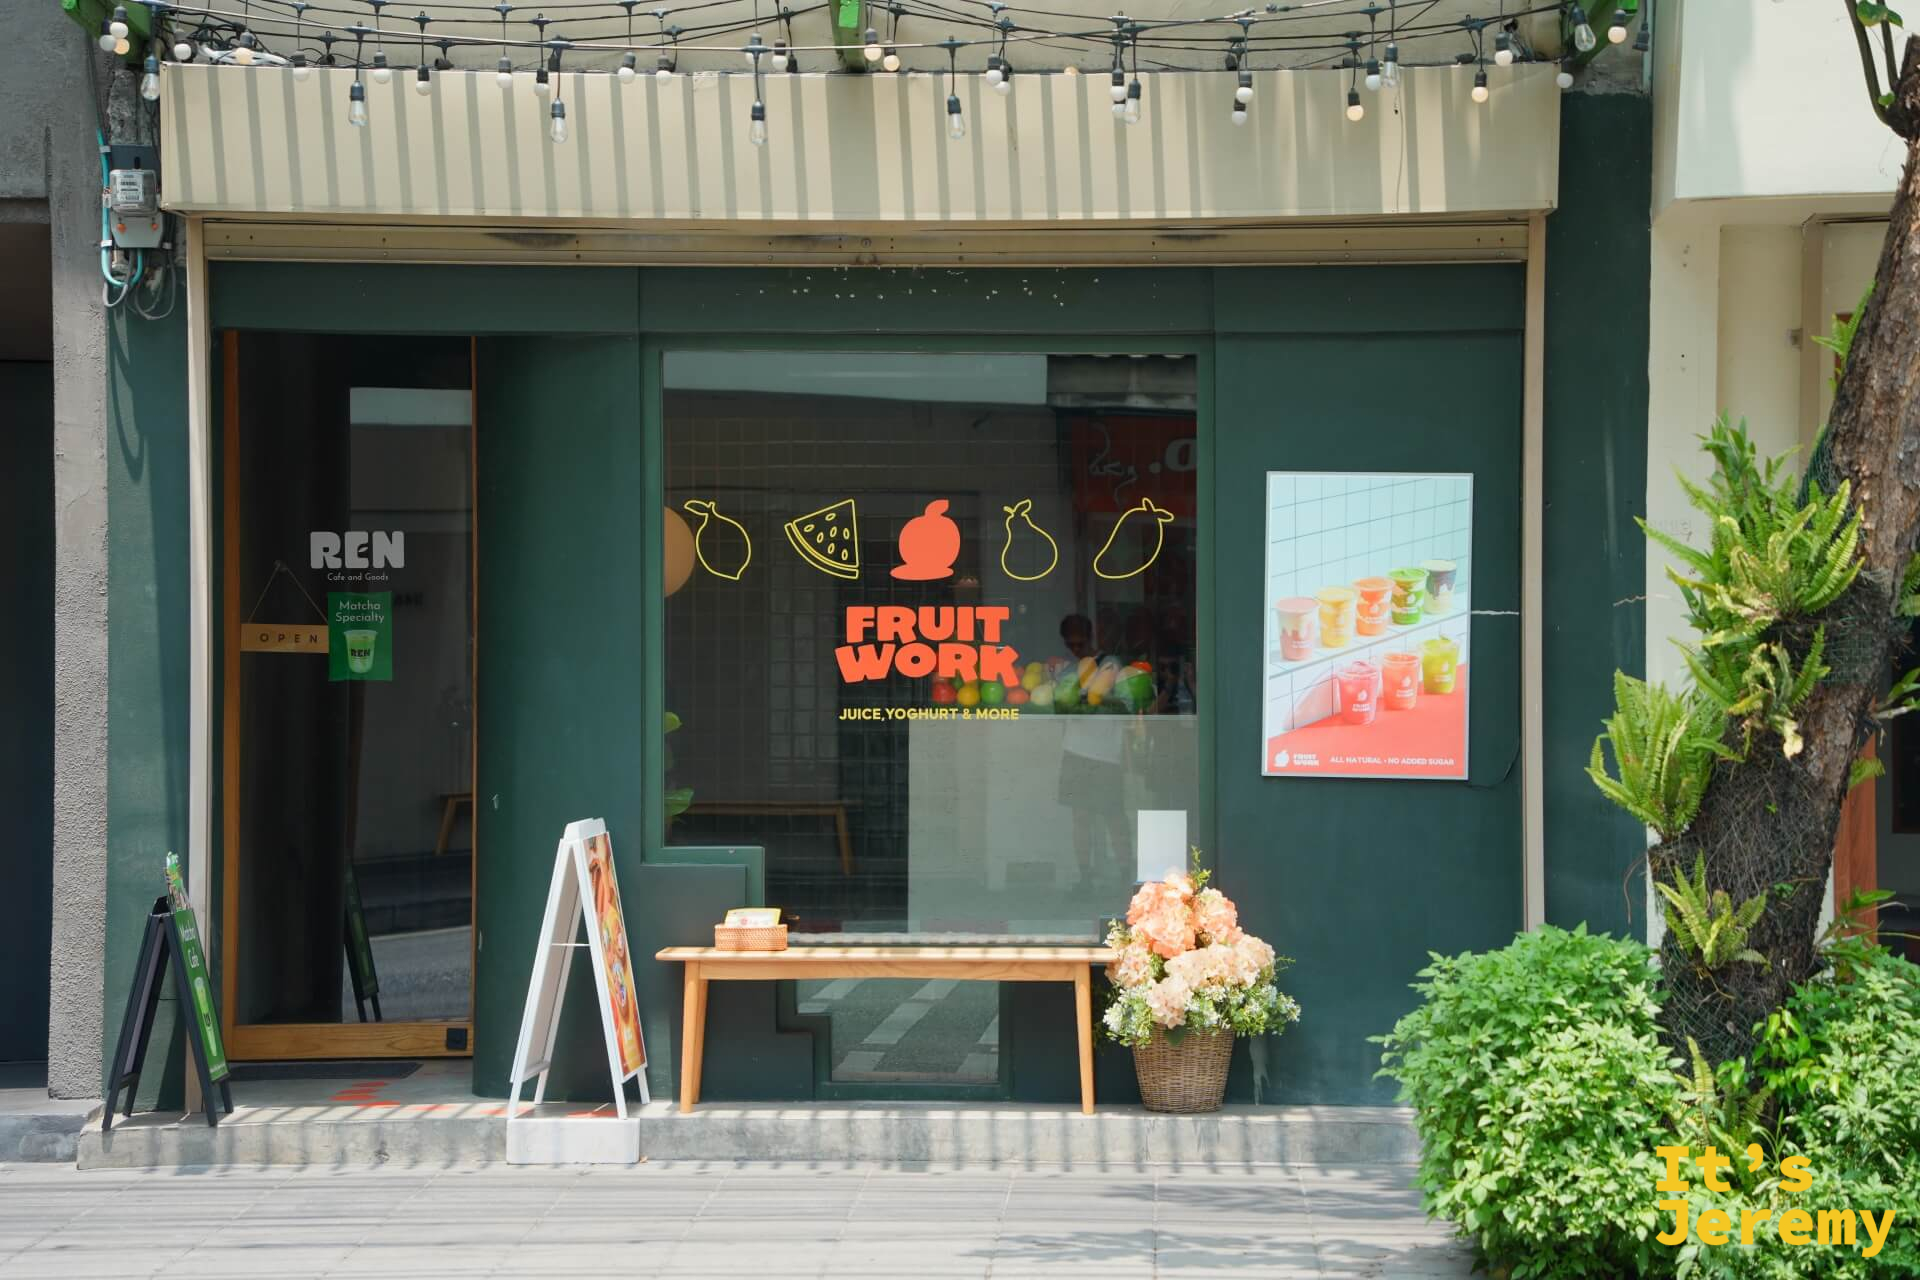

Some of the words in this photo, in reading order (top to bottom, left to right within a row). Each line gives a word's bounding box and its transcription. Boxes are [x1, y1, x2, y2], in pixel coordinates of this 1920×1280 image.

[310, 531, 405, 569] REN
[327, 571, 346, 581] Cafe
[347, 571, 362, 581] and
[364, 571, 389, 581] Goods
[339, 600, 381, 610] Matcha
[335, 611, 385, 623] Specialty
[846, 606, 1010, 644] FRUIT
[834, 642, 1020, 688] WORK
[963, 708, 971, 720] &
[976, 708, 1020, 720] MORE
[1346, 756, 1382, 765] NATURAL
[1388, 757, 1400, 765] NO
[1401, 757, 1427, 766] ADDED
[1428, 758, 1455, 766] SUGAR
